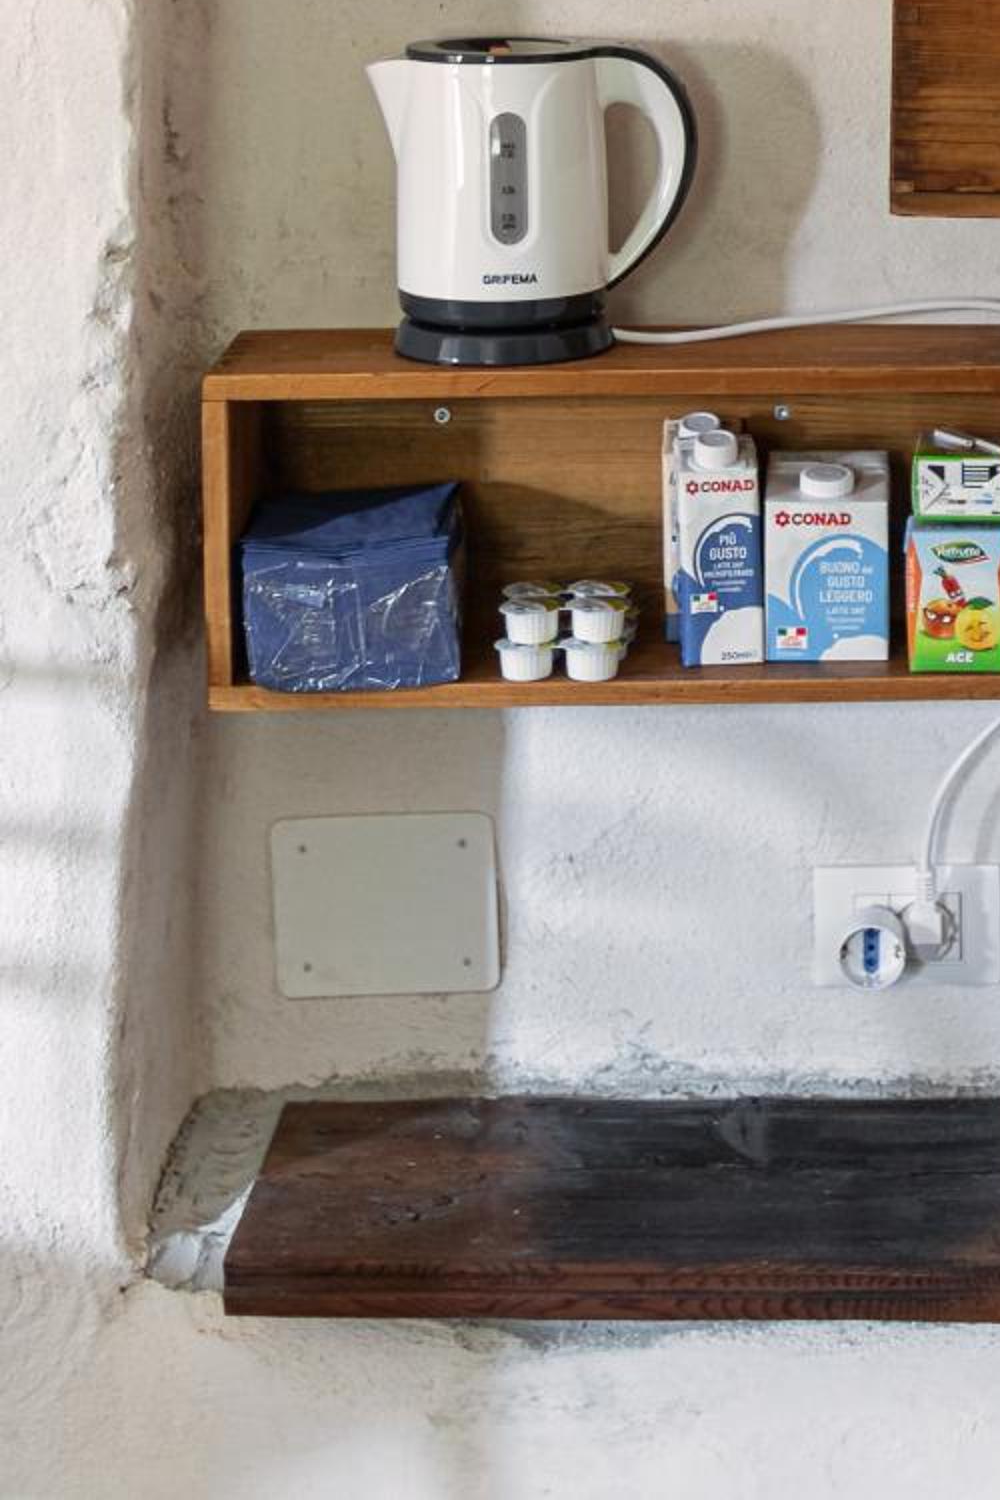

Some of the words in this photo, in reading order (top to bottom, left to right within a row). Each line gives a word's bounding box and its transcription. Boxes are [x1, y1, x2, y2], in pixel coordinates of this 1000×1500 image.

[482, 273, 538, 285] GRIFEMA
[701, 479, 755, 493] CONAD
[791, 512, 852, 526] CONAD
[709, 546, 747, 561] GUSTO
[819, 561, 860, 575] BUONO
[827, 575, 865, 589] GUSTO
[819, 589, 873, 604] LEGGERO
[945, 652, 975, 664] ACE
